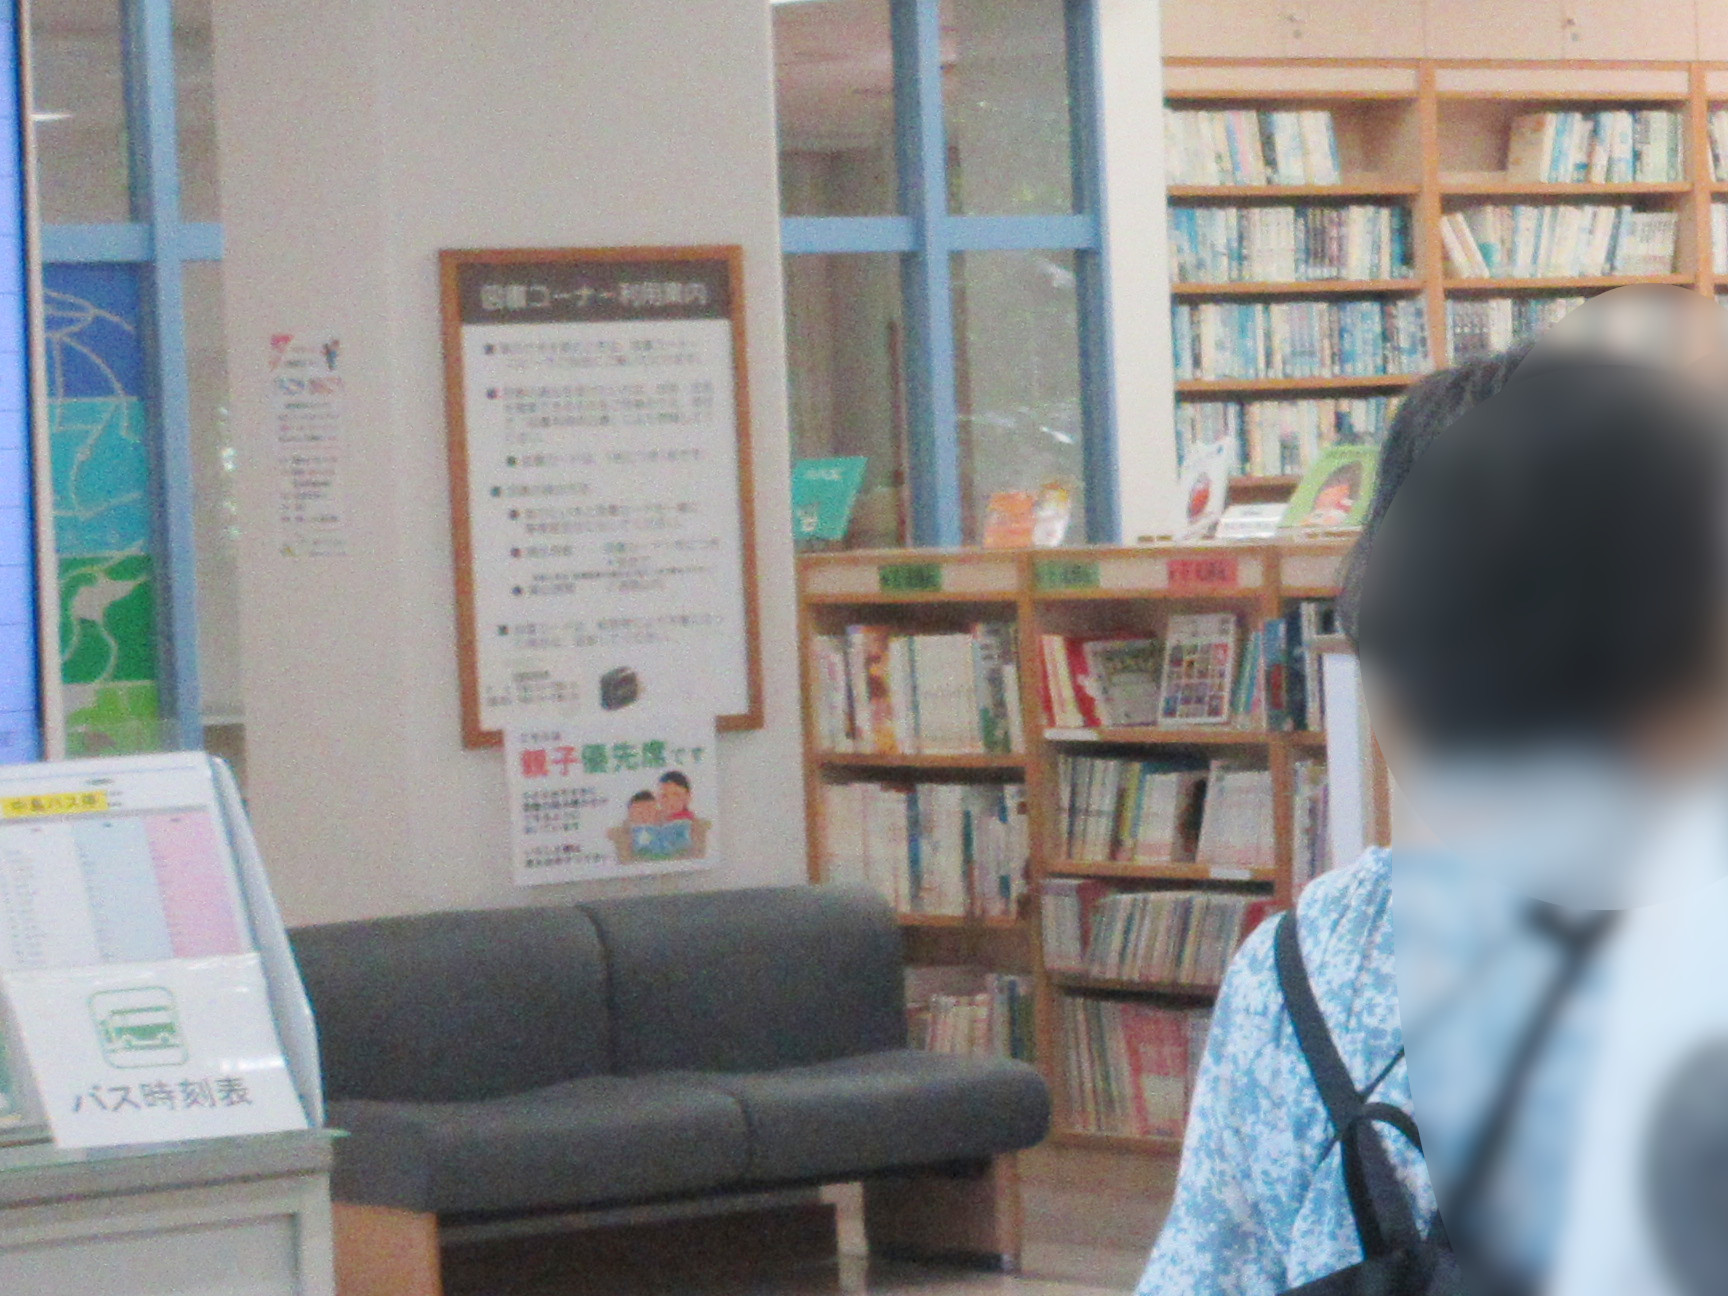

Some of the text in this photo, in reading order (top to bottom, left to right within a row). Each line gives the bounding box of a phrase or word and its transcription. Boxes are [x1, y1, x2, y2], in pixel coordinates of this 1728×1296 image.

[522, 739, 705, 779] 親子優先席です
[73, 1077, 253, 1113] バス時刻表
